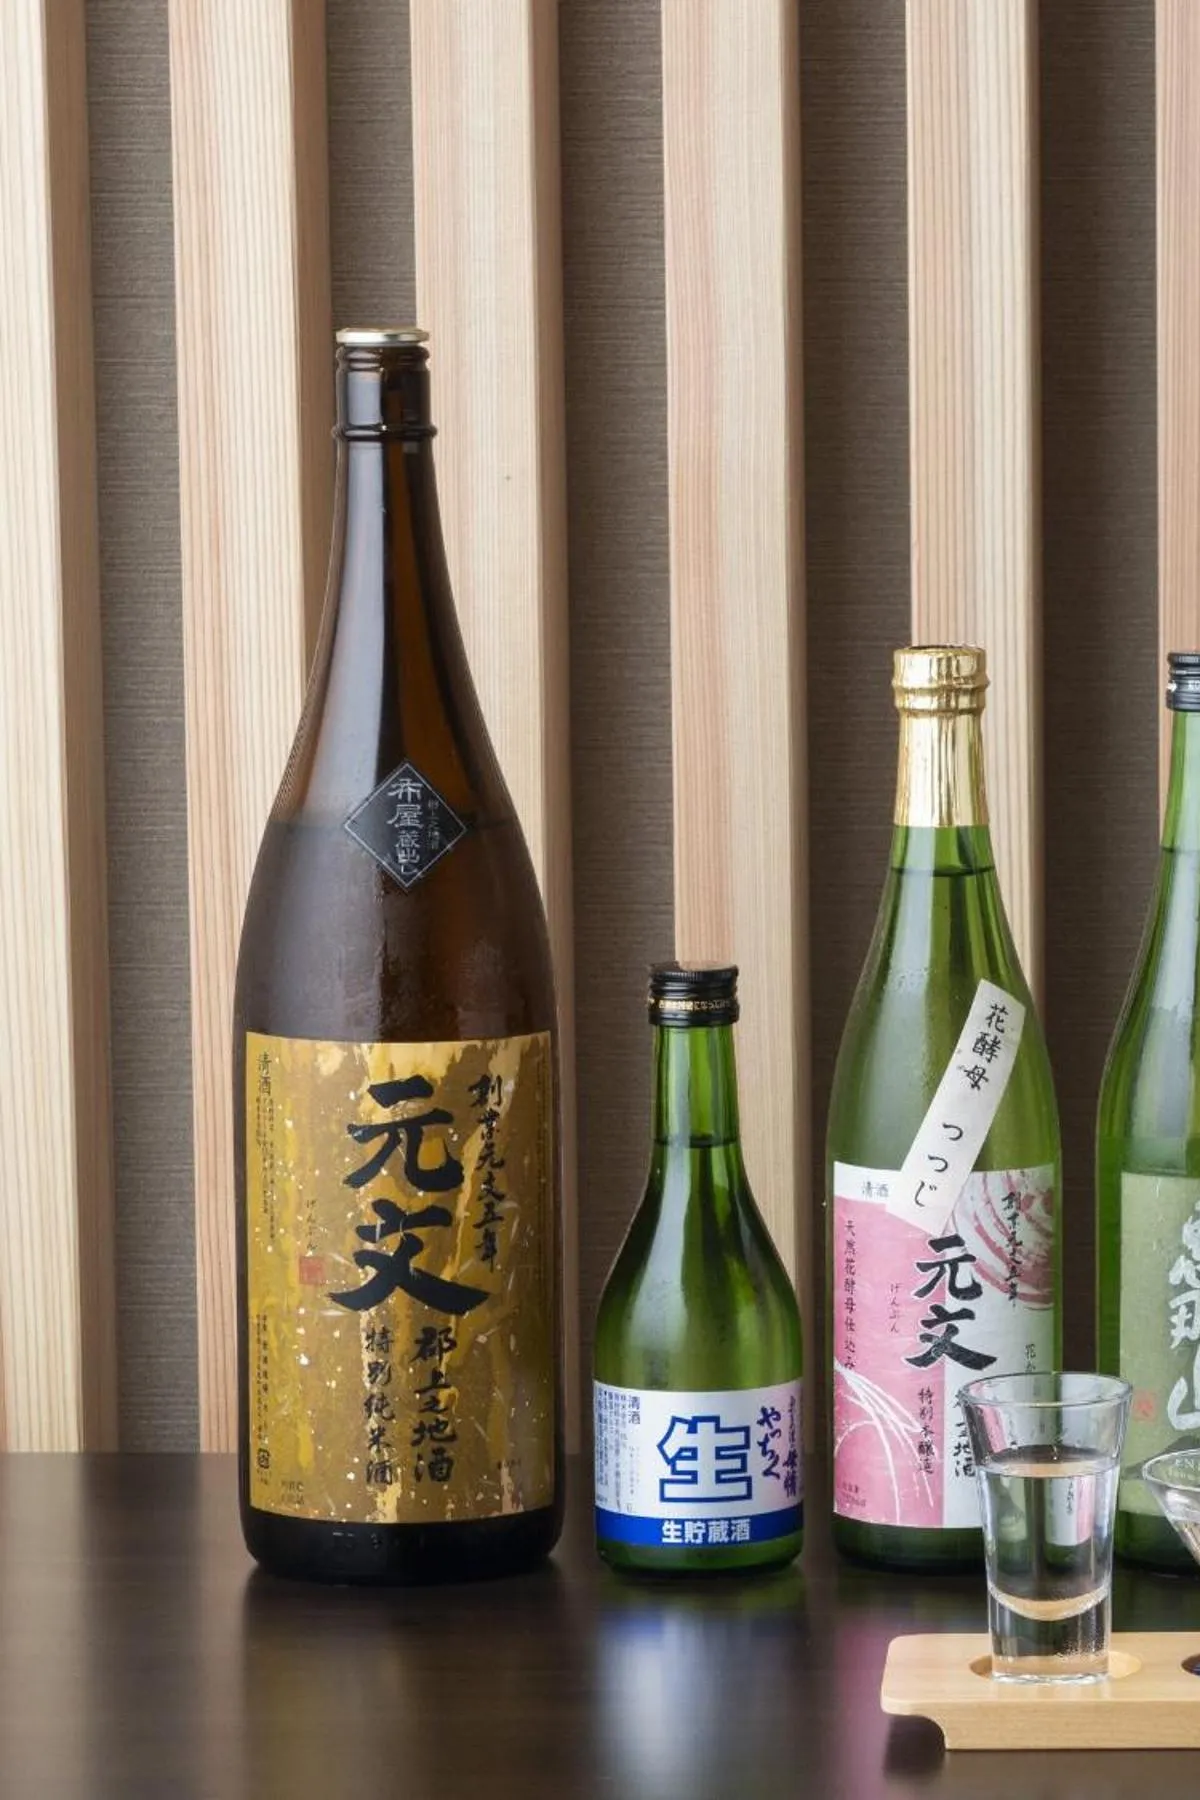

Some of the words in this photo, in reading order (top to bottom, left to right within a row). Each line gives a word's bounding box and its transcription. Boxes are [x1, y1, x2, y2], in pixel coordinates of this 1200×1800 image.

[964, 1002, 1009, 1091] 花酵母
[326, 1075, 490, 1316] 元文
[862, 1181, 889, 1198] 清酒
[914, 1122, 964, 1208] つつじ
[906, 1233, 998, 1370] 元文
[628, 1395, 641, 1425] 清酒
[756, 1405, 782, 1480] やっちく
[656, 1415, 753, 1502] 生
[661, 1518, 751, 1544] 生貯蔵酒
